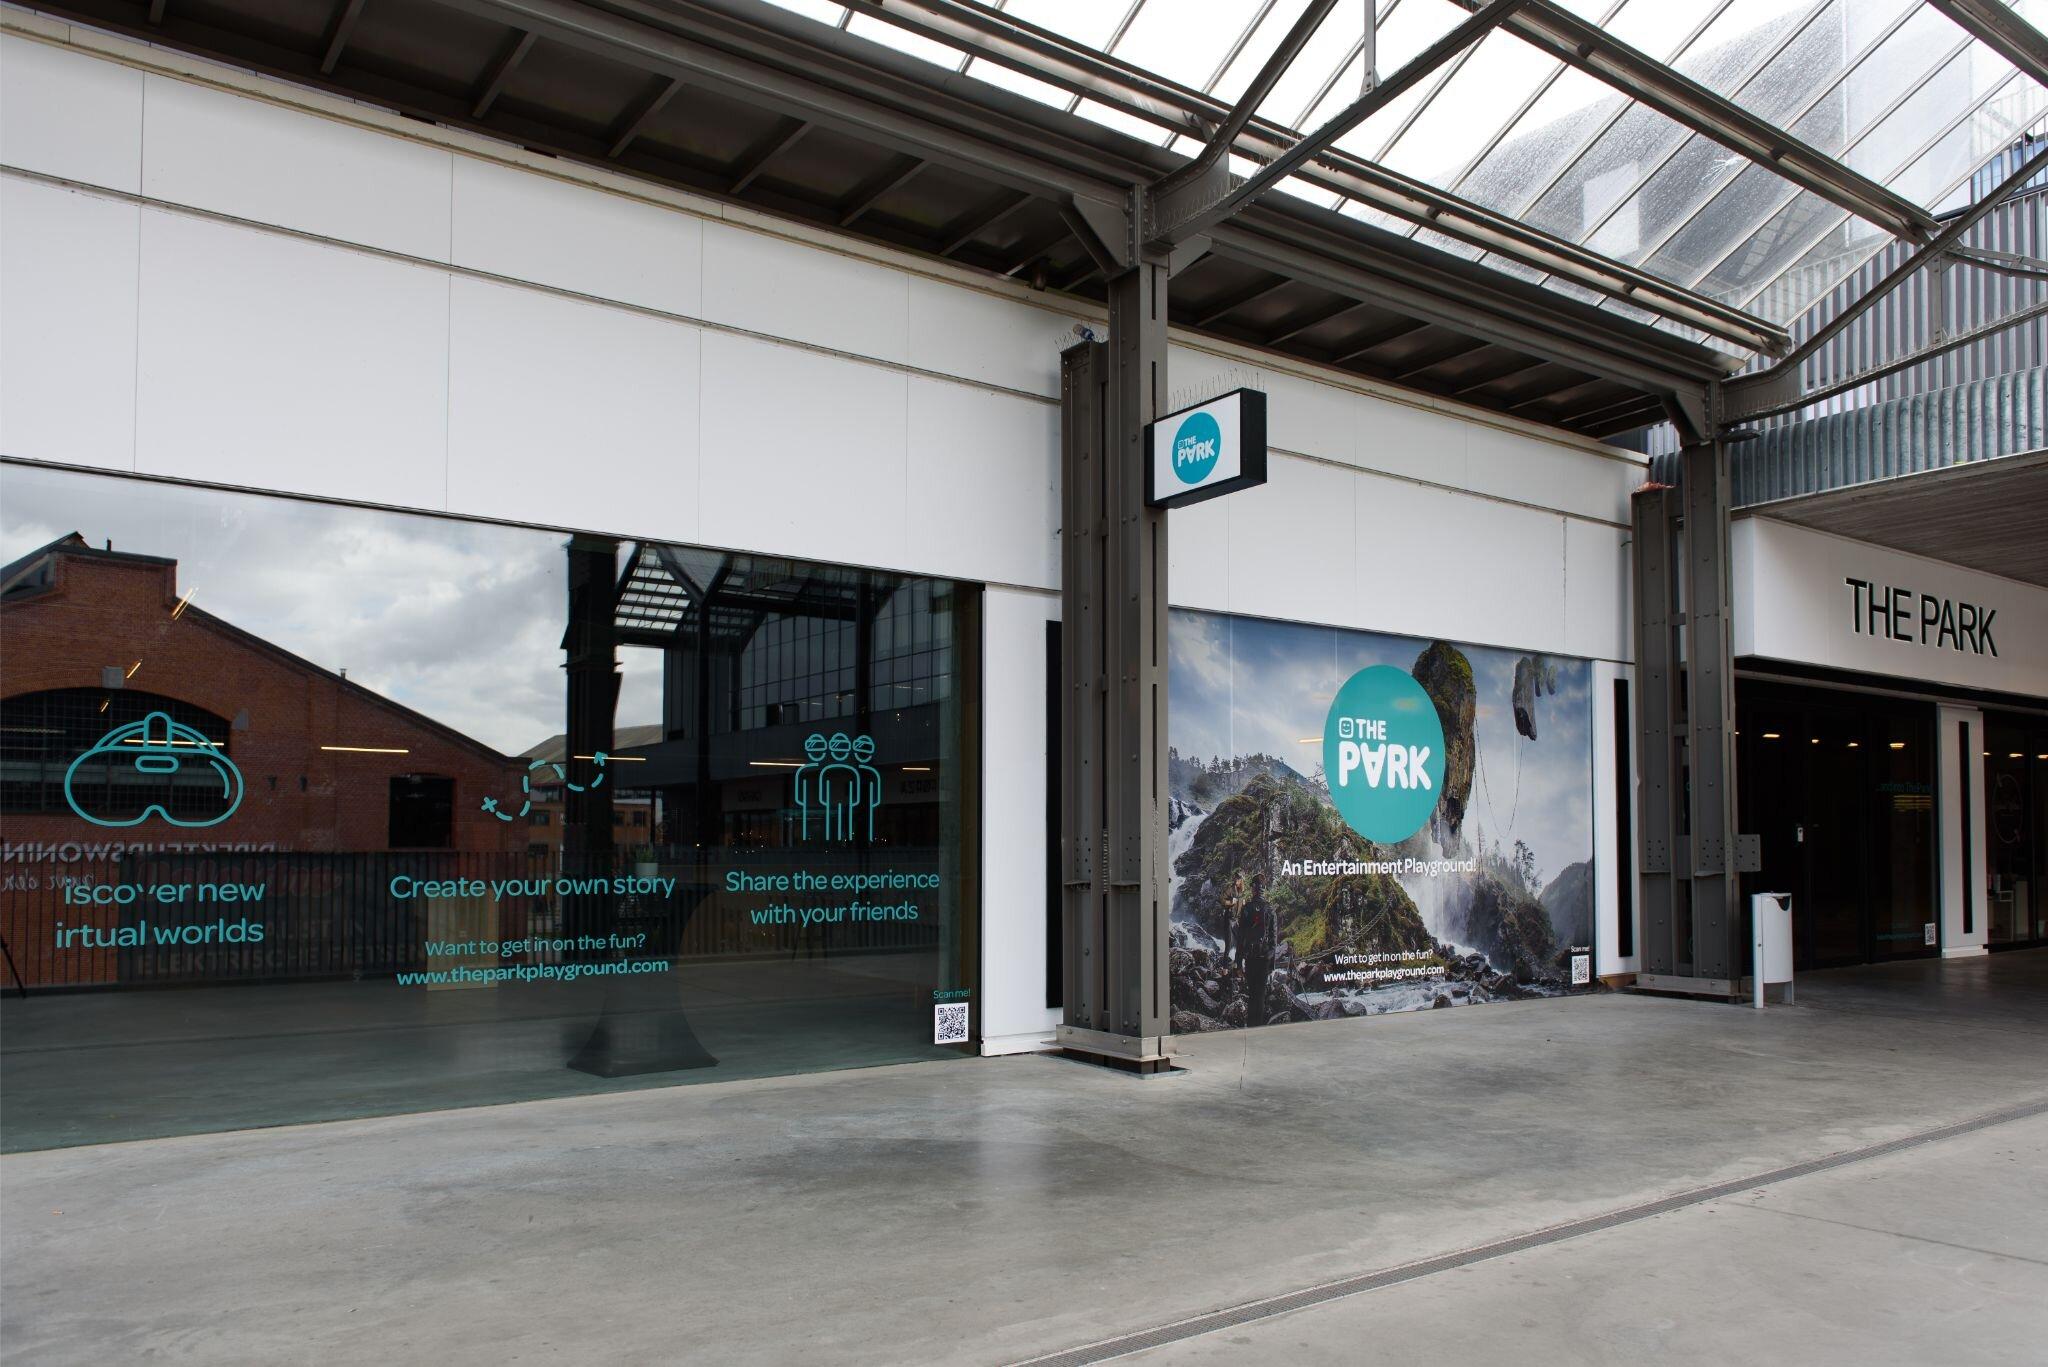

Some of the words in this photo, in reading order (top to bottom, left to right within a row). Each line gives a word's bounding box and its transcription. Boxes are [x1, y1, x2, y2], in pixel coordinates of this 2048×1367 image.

[1177, 438, 1215, 467] PARK
[1184, 435, 1197, 445] THE
[1845, 577, 1913, 643] THE
[1919, 593, 1999, 658] PARK
[1356, 718, 1387, 741] THE
[1338, 739, 1432, 790] PARK
[1281, 859, 1301, 876] An
[1303, 858, 1402, 876] Entertainment
[1404, 857, 1476, 877] Playground!
[196, 882, 267, 904] new
[389, 873, 486, 900] Create
[491, 879, 551, 902] your
[555, 877, 609, 896] own
[612, 874, 677, 898] story
[725, 870, 790, 893] Share
[793, 871, 829, 891] the
[830, 868, 940, 894] experience
[751, 904, 797, 926] with
[799, 905, 848, 928] your
[849, 900, 919, 922] friends
[153, 915, 265, 945] worlds
[425, 940, 477, 957] Want
[480, 939, 499, 954] to
[501, 938, 530, 958] get
[534, 936, 552, 951] in
[552, 937, 575, 952] on
[577, 934, 606, 951] the
[608, 932, 646, 949] fun?
[1335, 953, 1357, 965] Want
[1358, 953, 1367, 963] to
[1369, 952, 1381, 965] get
[1382, 951, 1390, 961] in
[1391, 952, 1400, 962] on
[1402, 950, 1415, 960] the
[1416, 948, 1433, 960] fun?
[396, 957, 670, 986] www.theparkplayground.com
[1323, 965, 1444, 982] www.theparkplayground.com
[933, 990, 953, 999] Scan
[955, 987, 970, 998] me!
